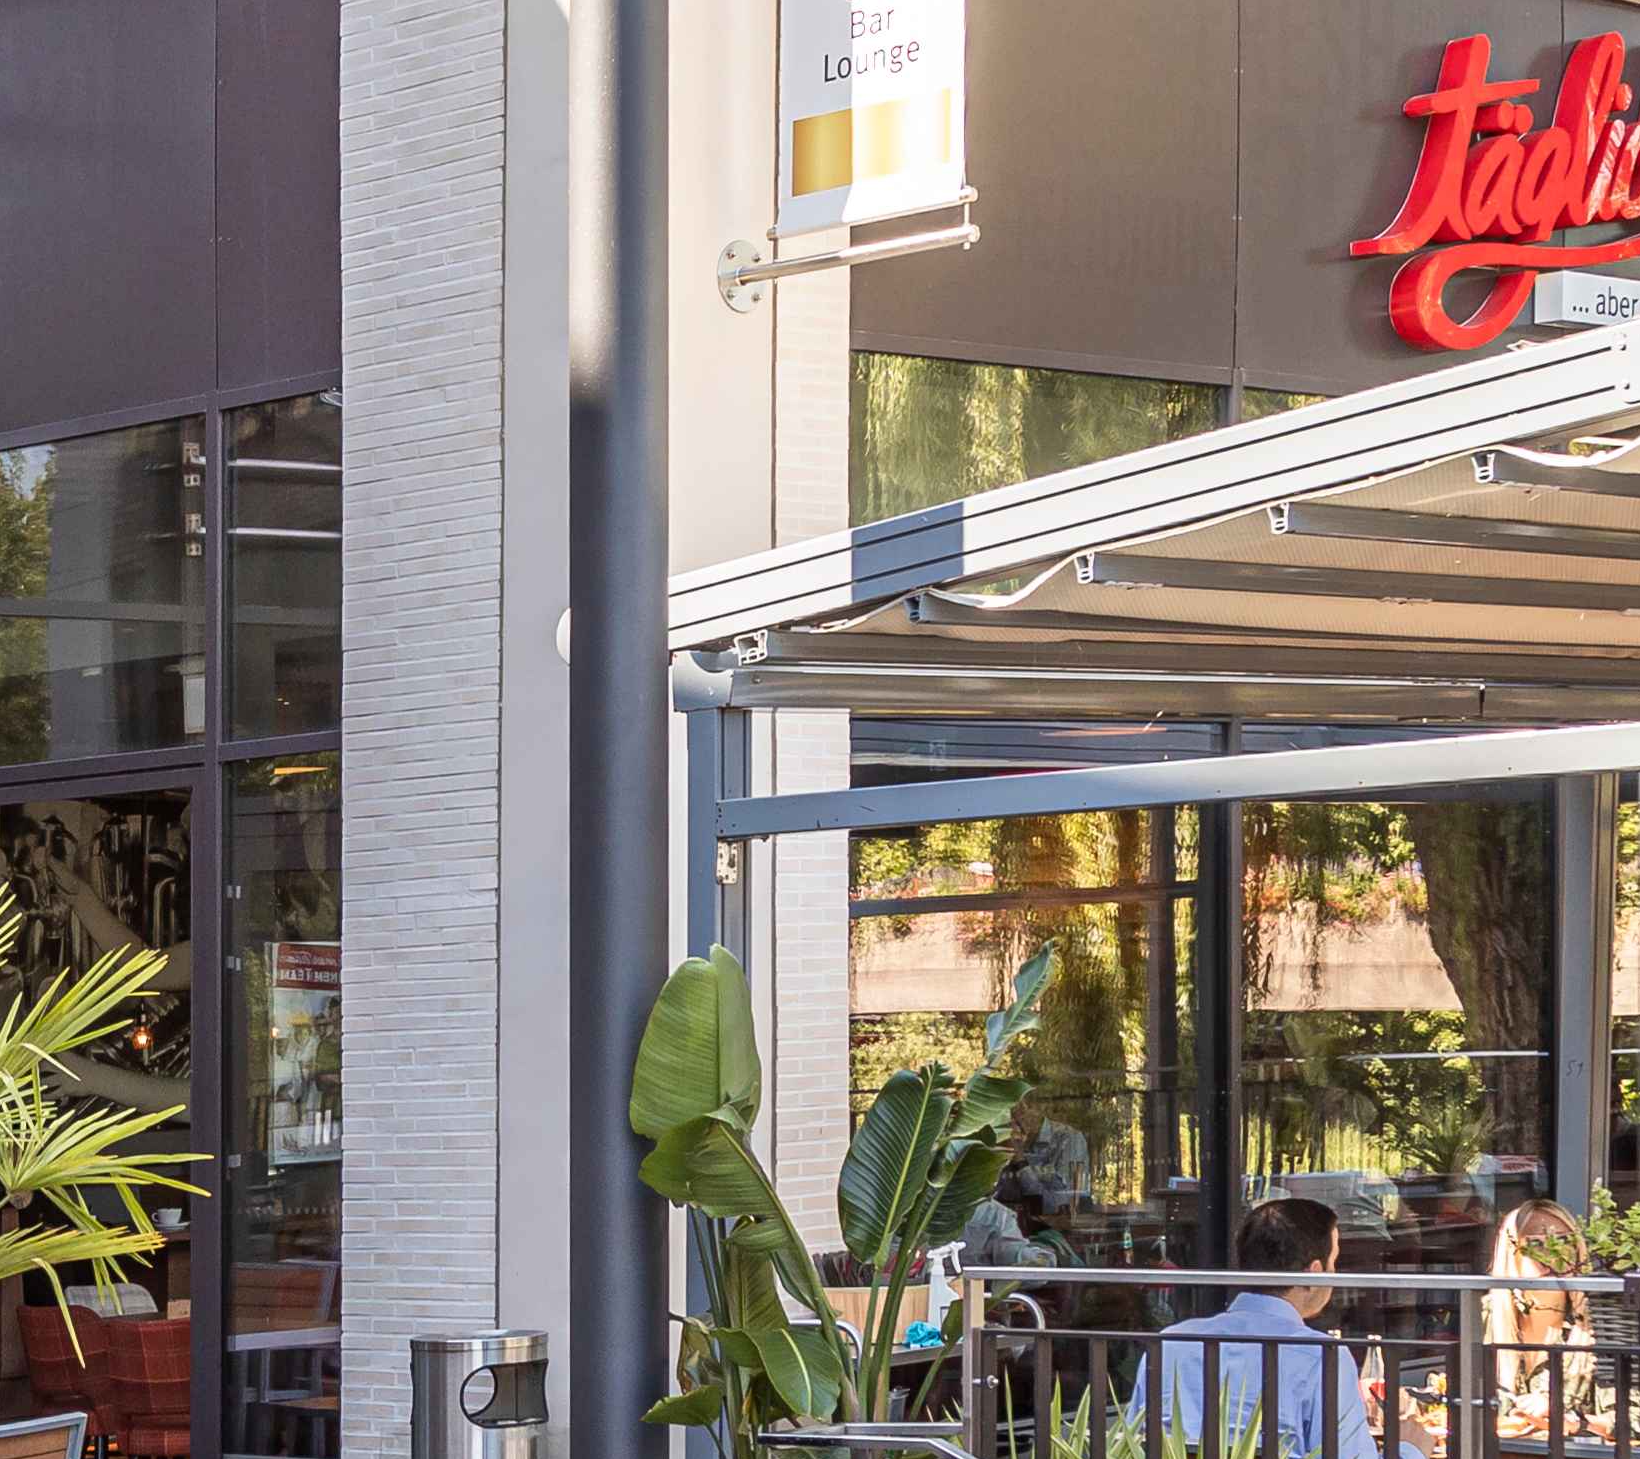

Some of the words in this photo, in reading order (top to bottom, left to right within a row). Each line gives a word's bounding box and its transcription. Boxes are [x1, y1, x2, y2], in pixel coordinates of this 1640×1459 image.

[850, 8, 895, 39] Bar
[823, 40, 920, 83] Lounge
[1595, 285, 1639, 319] aber
